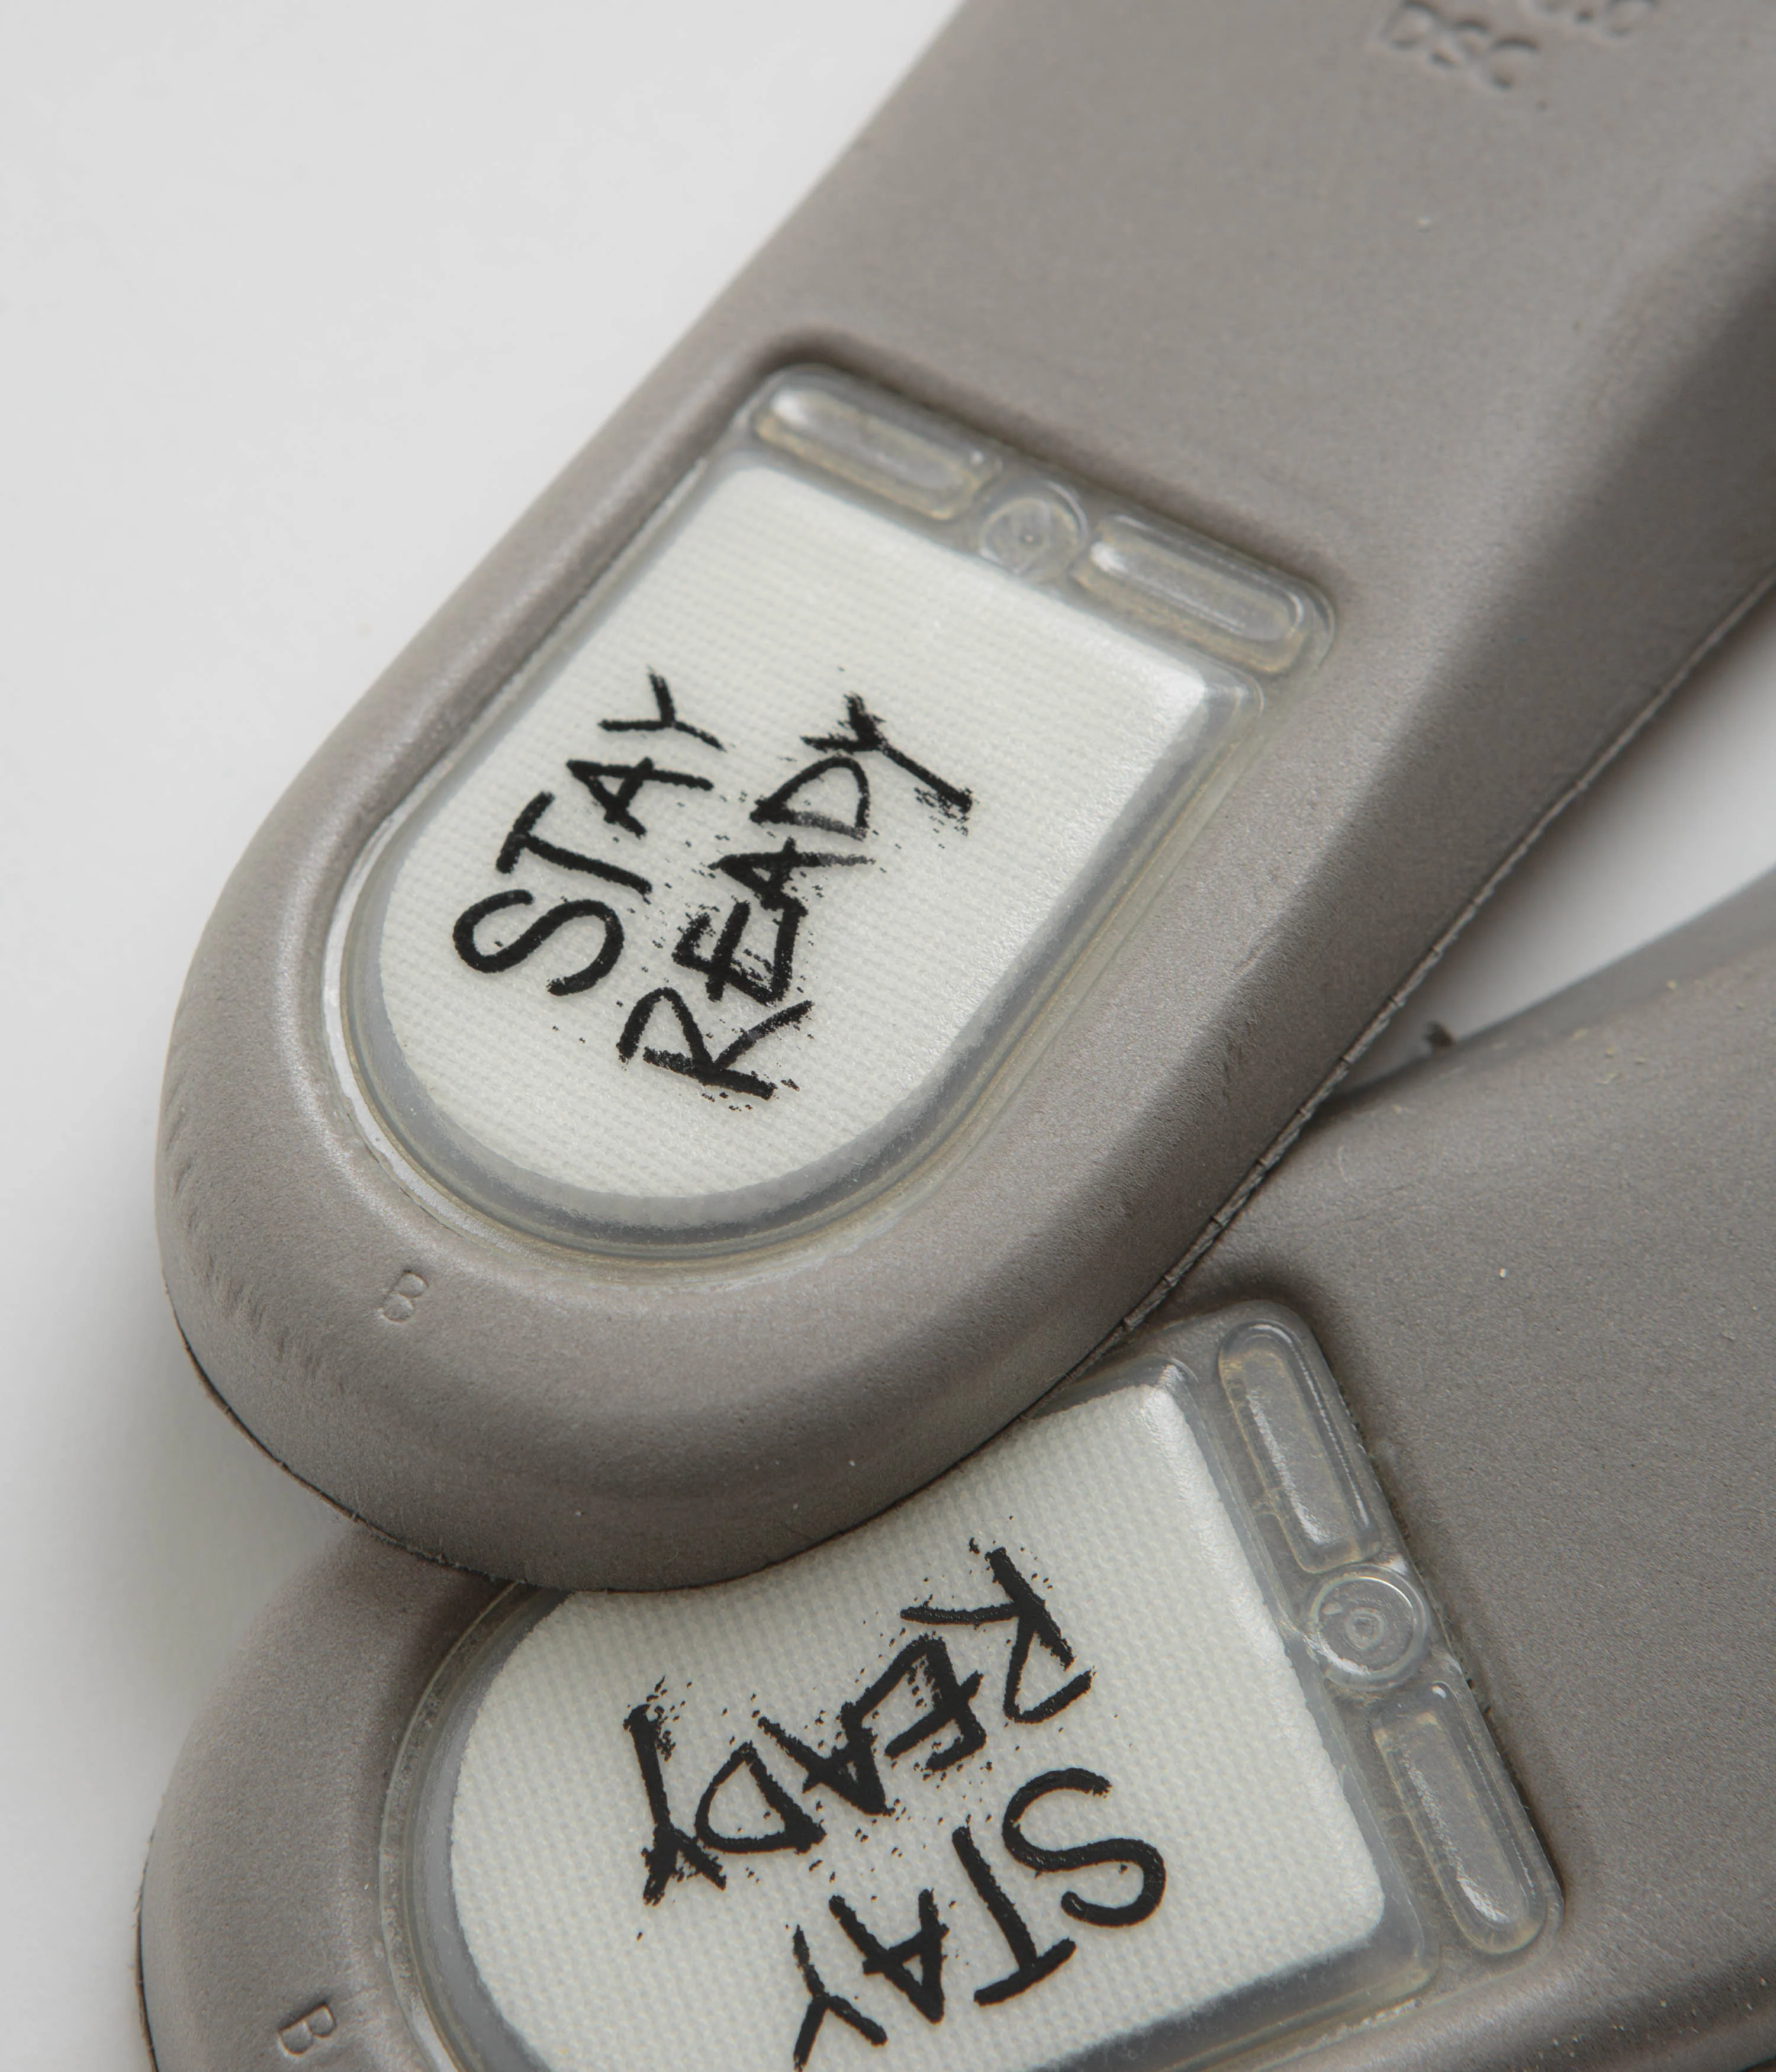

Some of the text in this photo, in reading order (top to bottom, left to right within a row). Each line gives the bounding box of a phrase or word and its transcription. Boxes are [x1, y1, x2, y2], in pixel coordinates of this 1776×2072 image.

[452, 665, 726, 997] STAY
[617, 691, 974, 1101] READY
[623, 1546, 1095, 1905] READY
[276, 2001, 336, 2055] B
[792, 1767, 1166, 2071] STAY
